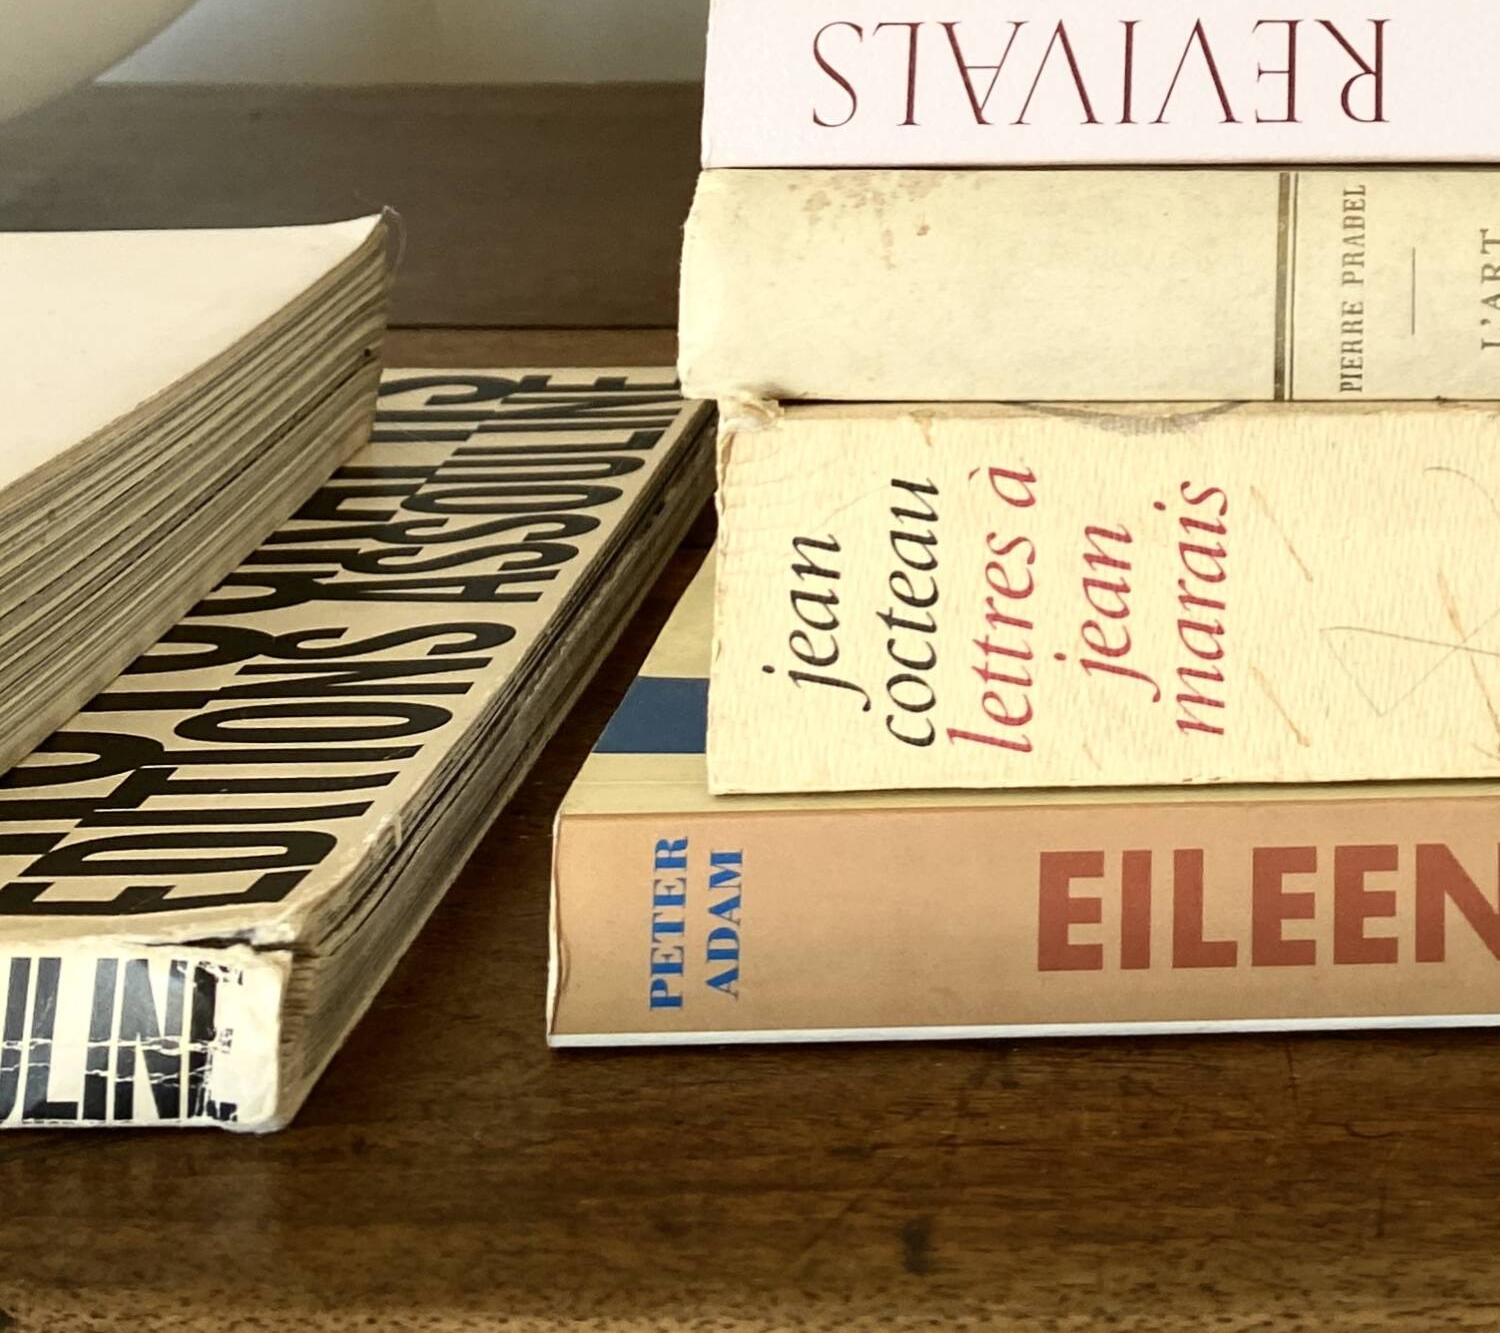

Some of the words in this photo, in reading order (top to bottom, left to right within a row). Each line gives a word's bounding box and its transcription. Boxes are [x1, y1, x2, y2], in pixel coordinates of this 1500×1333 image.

[812, 17, 1390, 128] REVIVALS
[1341, 184, 1367, 288] PRADEL
[1339, 301, 1365, 393] PIERRE
[968, 465, 1038, 509] à
[0, 621, 515, 916] EDITIONS
[307, 374, 679, 603] ASSOULINE
[762, 533, 872, 712] jean
[876, 477, 940, 747] cocteau
[946, 531, 1037, 753] lettres
[1053, 524, 1162, 702] jean
[1153, 480, 1229, 736] marais
[649, 836, 689, 1011] PETER
[704, 849, 744, 998] ADAM
